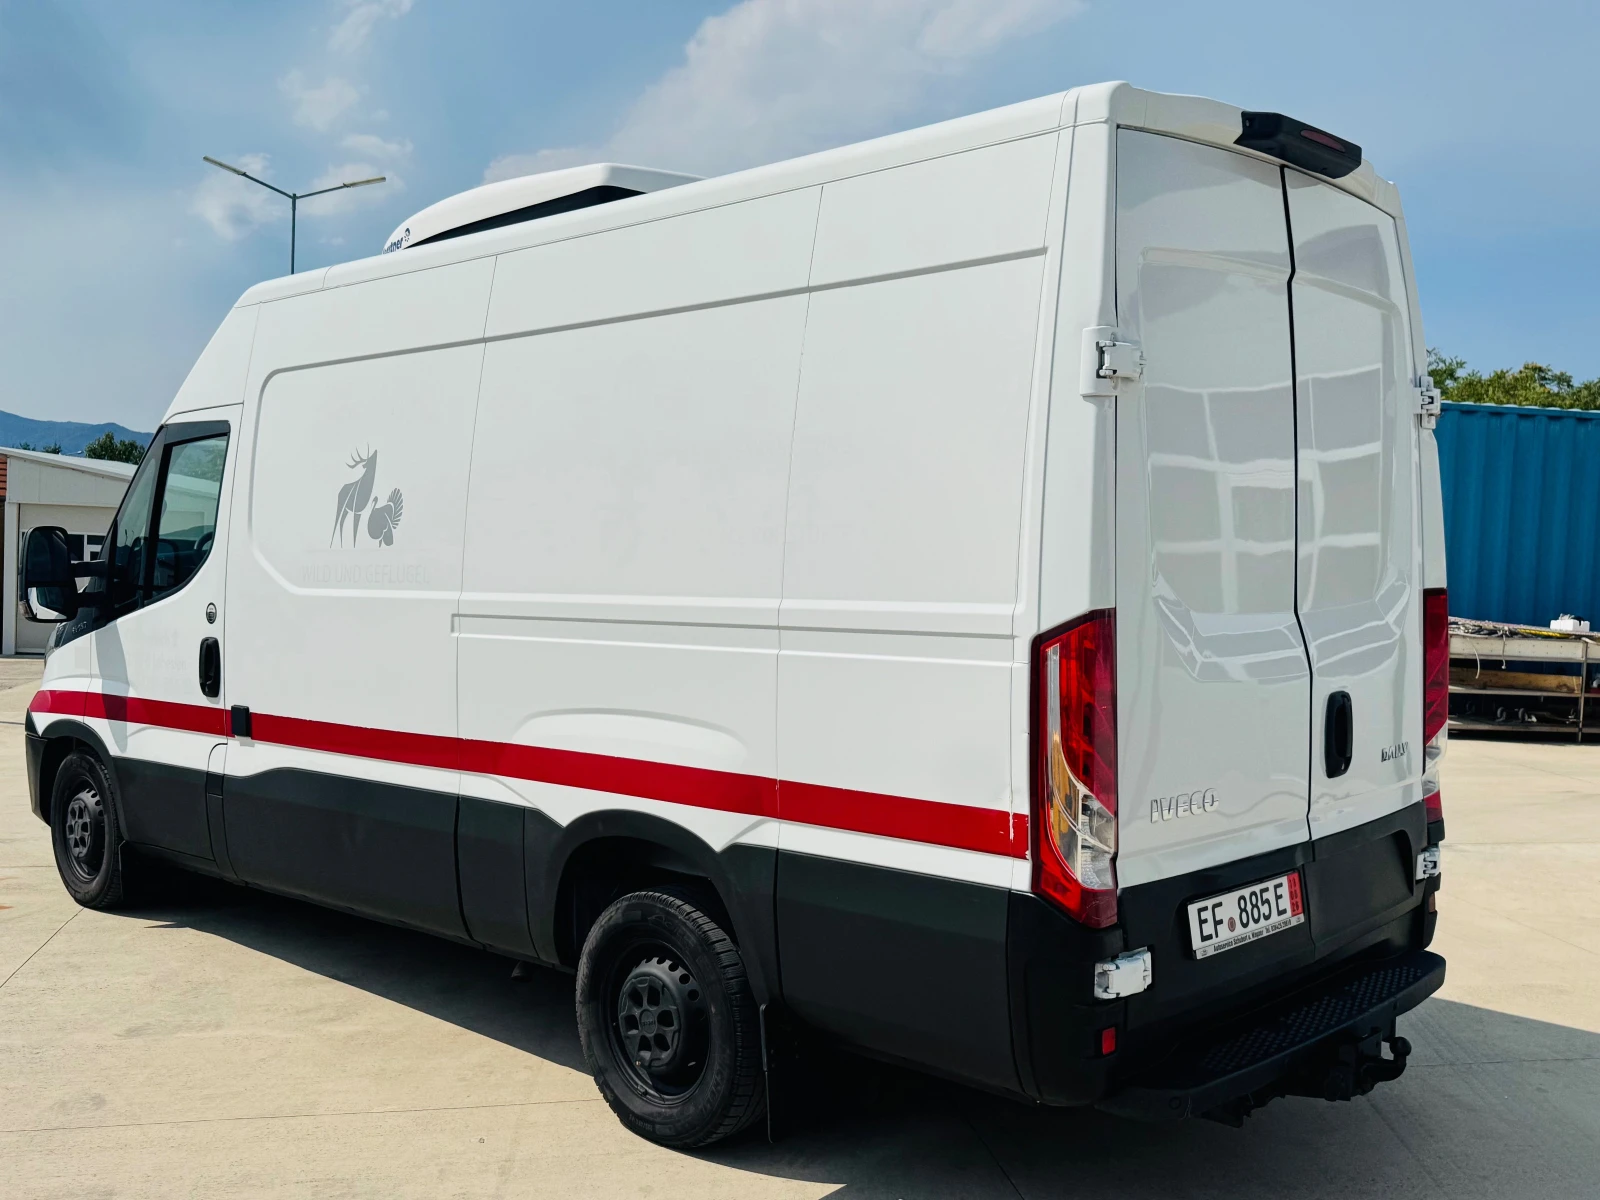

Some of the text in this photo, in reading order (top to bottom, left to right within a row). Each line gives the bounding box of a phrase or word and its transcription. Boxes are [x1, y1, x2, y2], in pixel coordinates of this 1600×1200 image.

[302, 564, 331, 583] WILD
[335, 564, 361, 584] UND
[1381, 741, 1409, 763] DAILY
[1151, 787, 1219, 823] IVECO
[1197, 901, 1224, 943] EF
